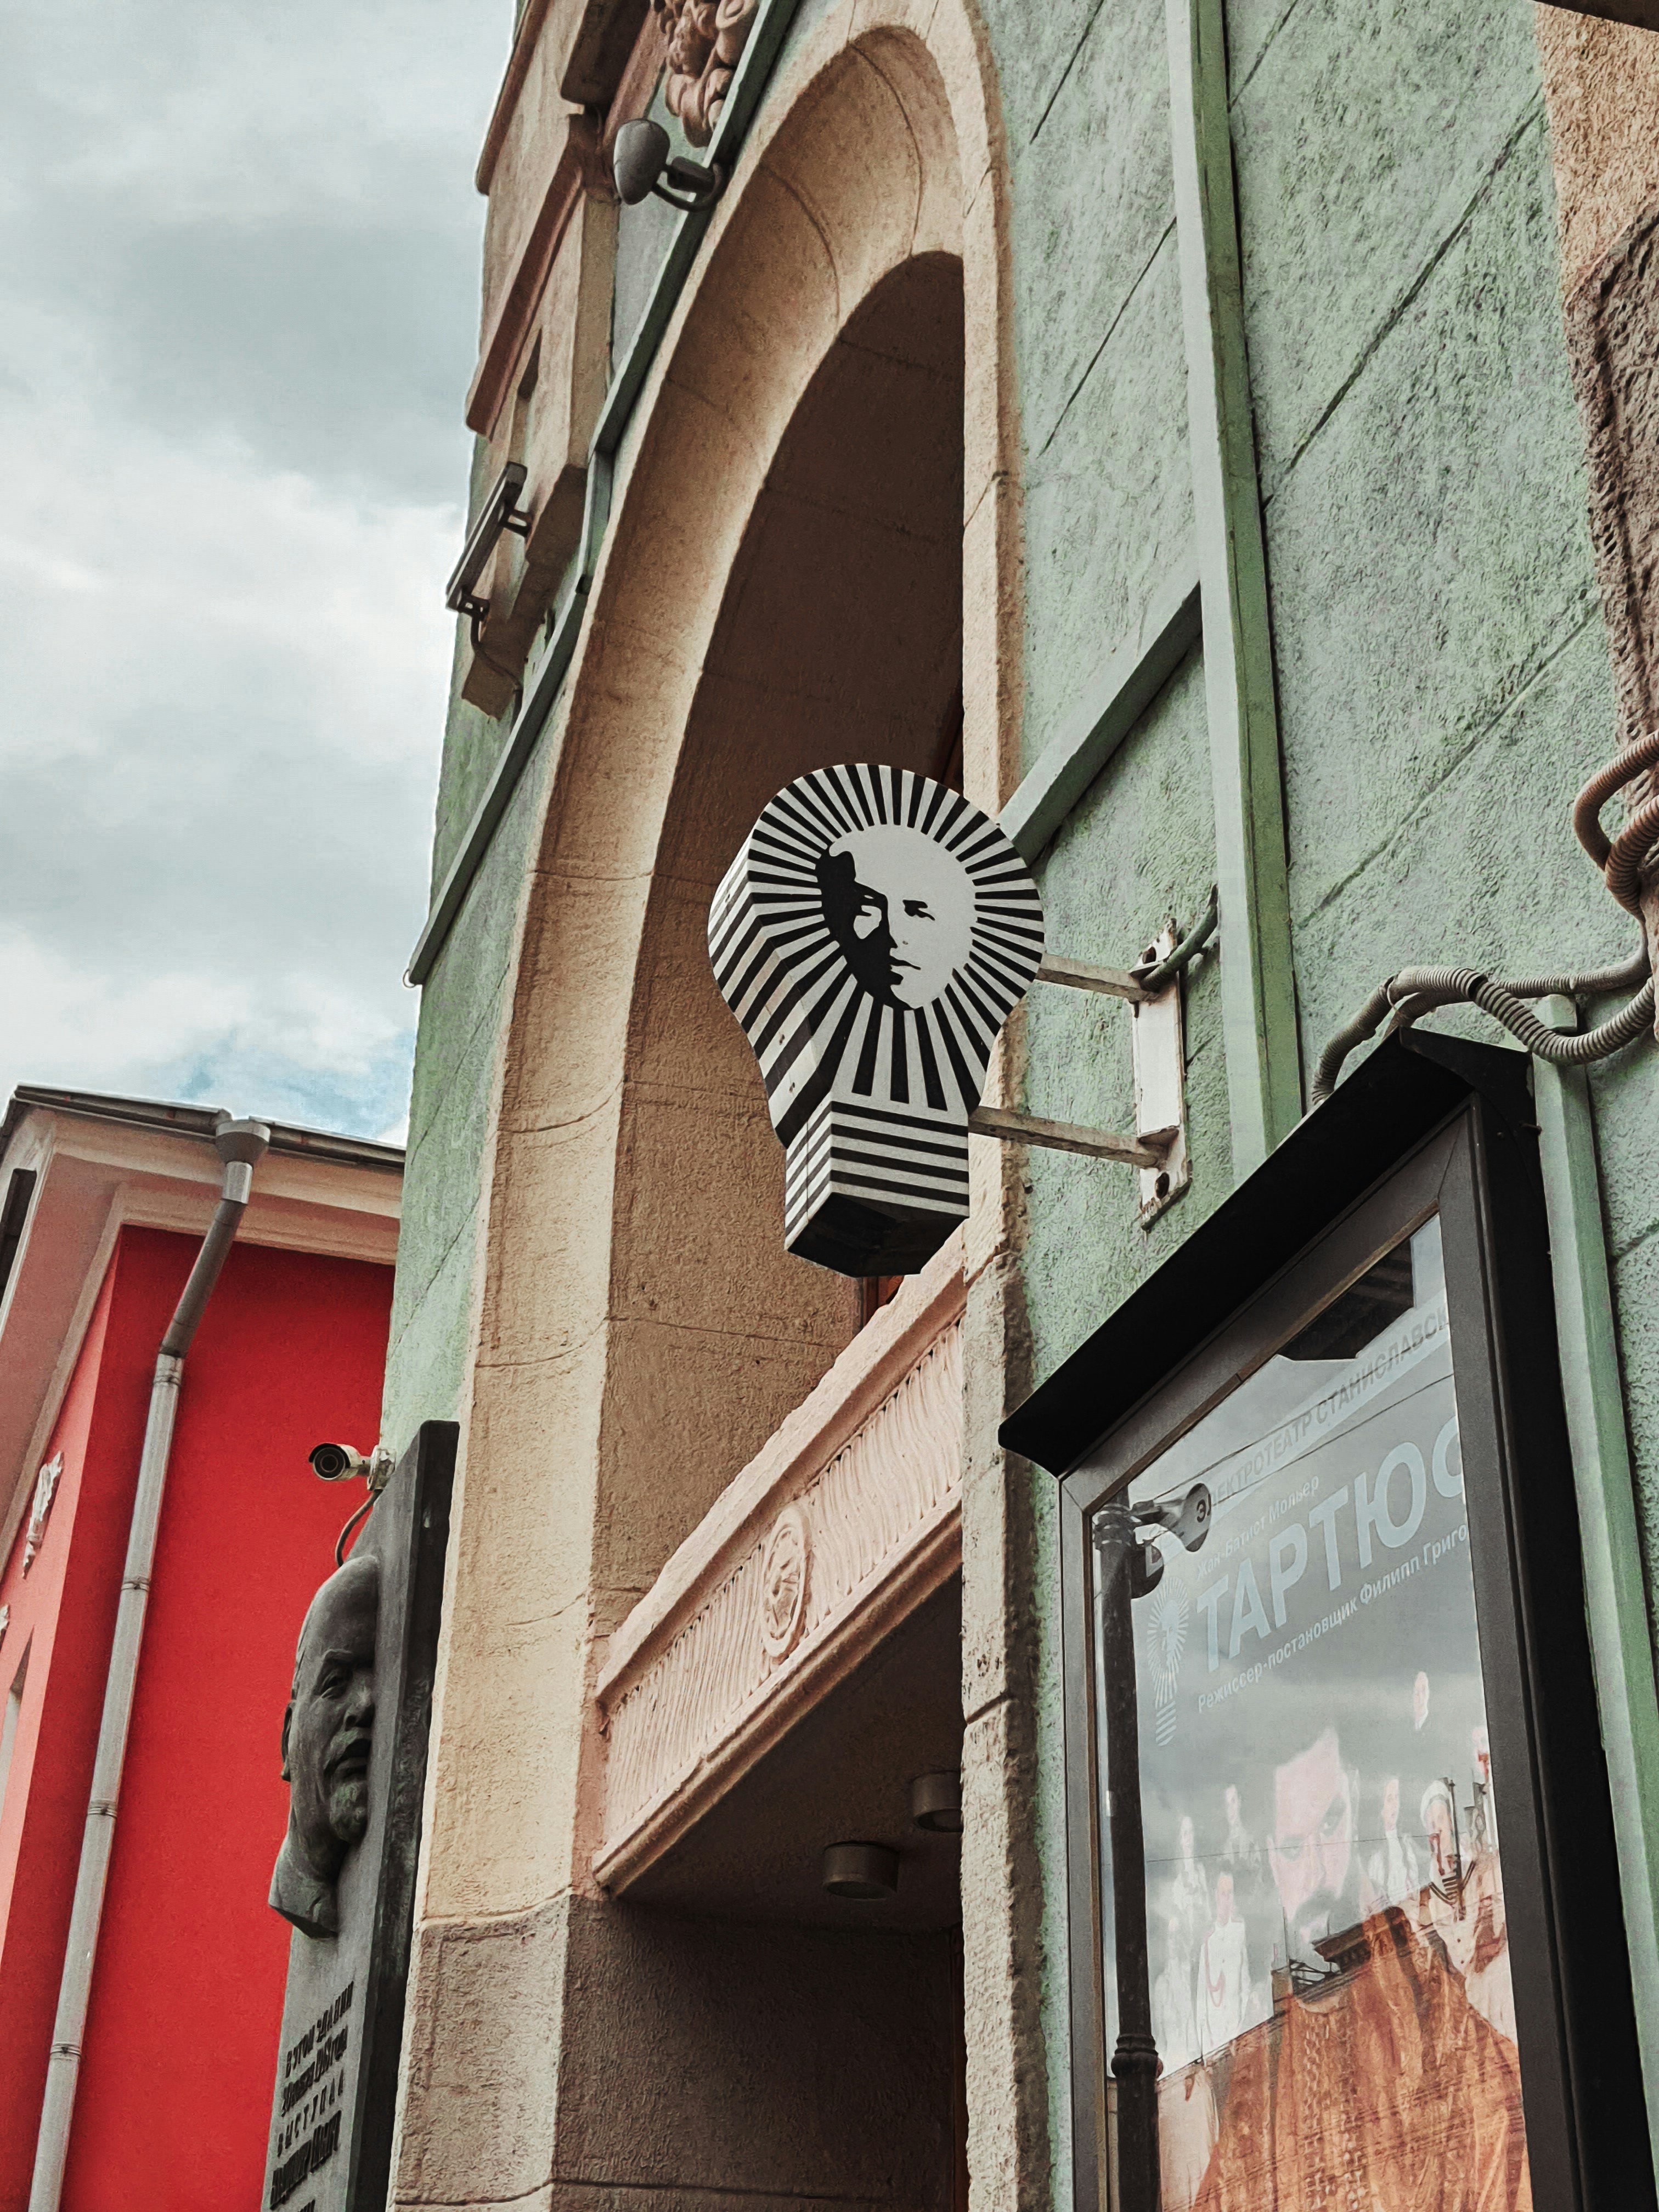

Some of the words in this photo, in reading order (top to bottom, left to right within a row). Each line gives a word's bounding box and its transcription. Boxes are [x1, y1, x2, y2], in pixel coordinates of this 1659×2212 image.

[1197, 1517, 1266, 1581] Жан-Батист
[1268, 1475, 1319, 1523] Мольер
[1198, 1597, 1358, 1713] Режиссер-постановщик
[1359, 1556, 1420, 1605] Филипп
